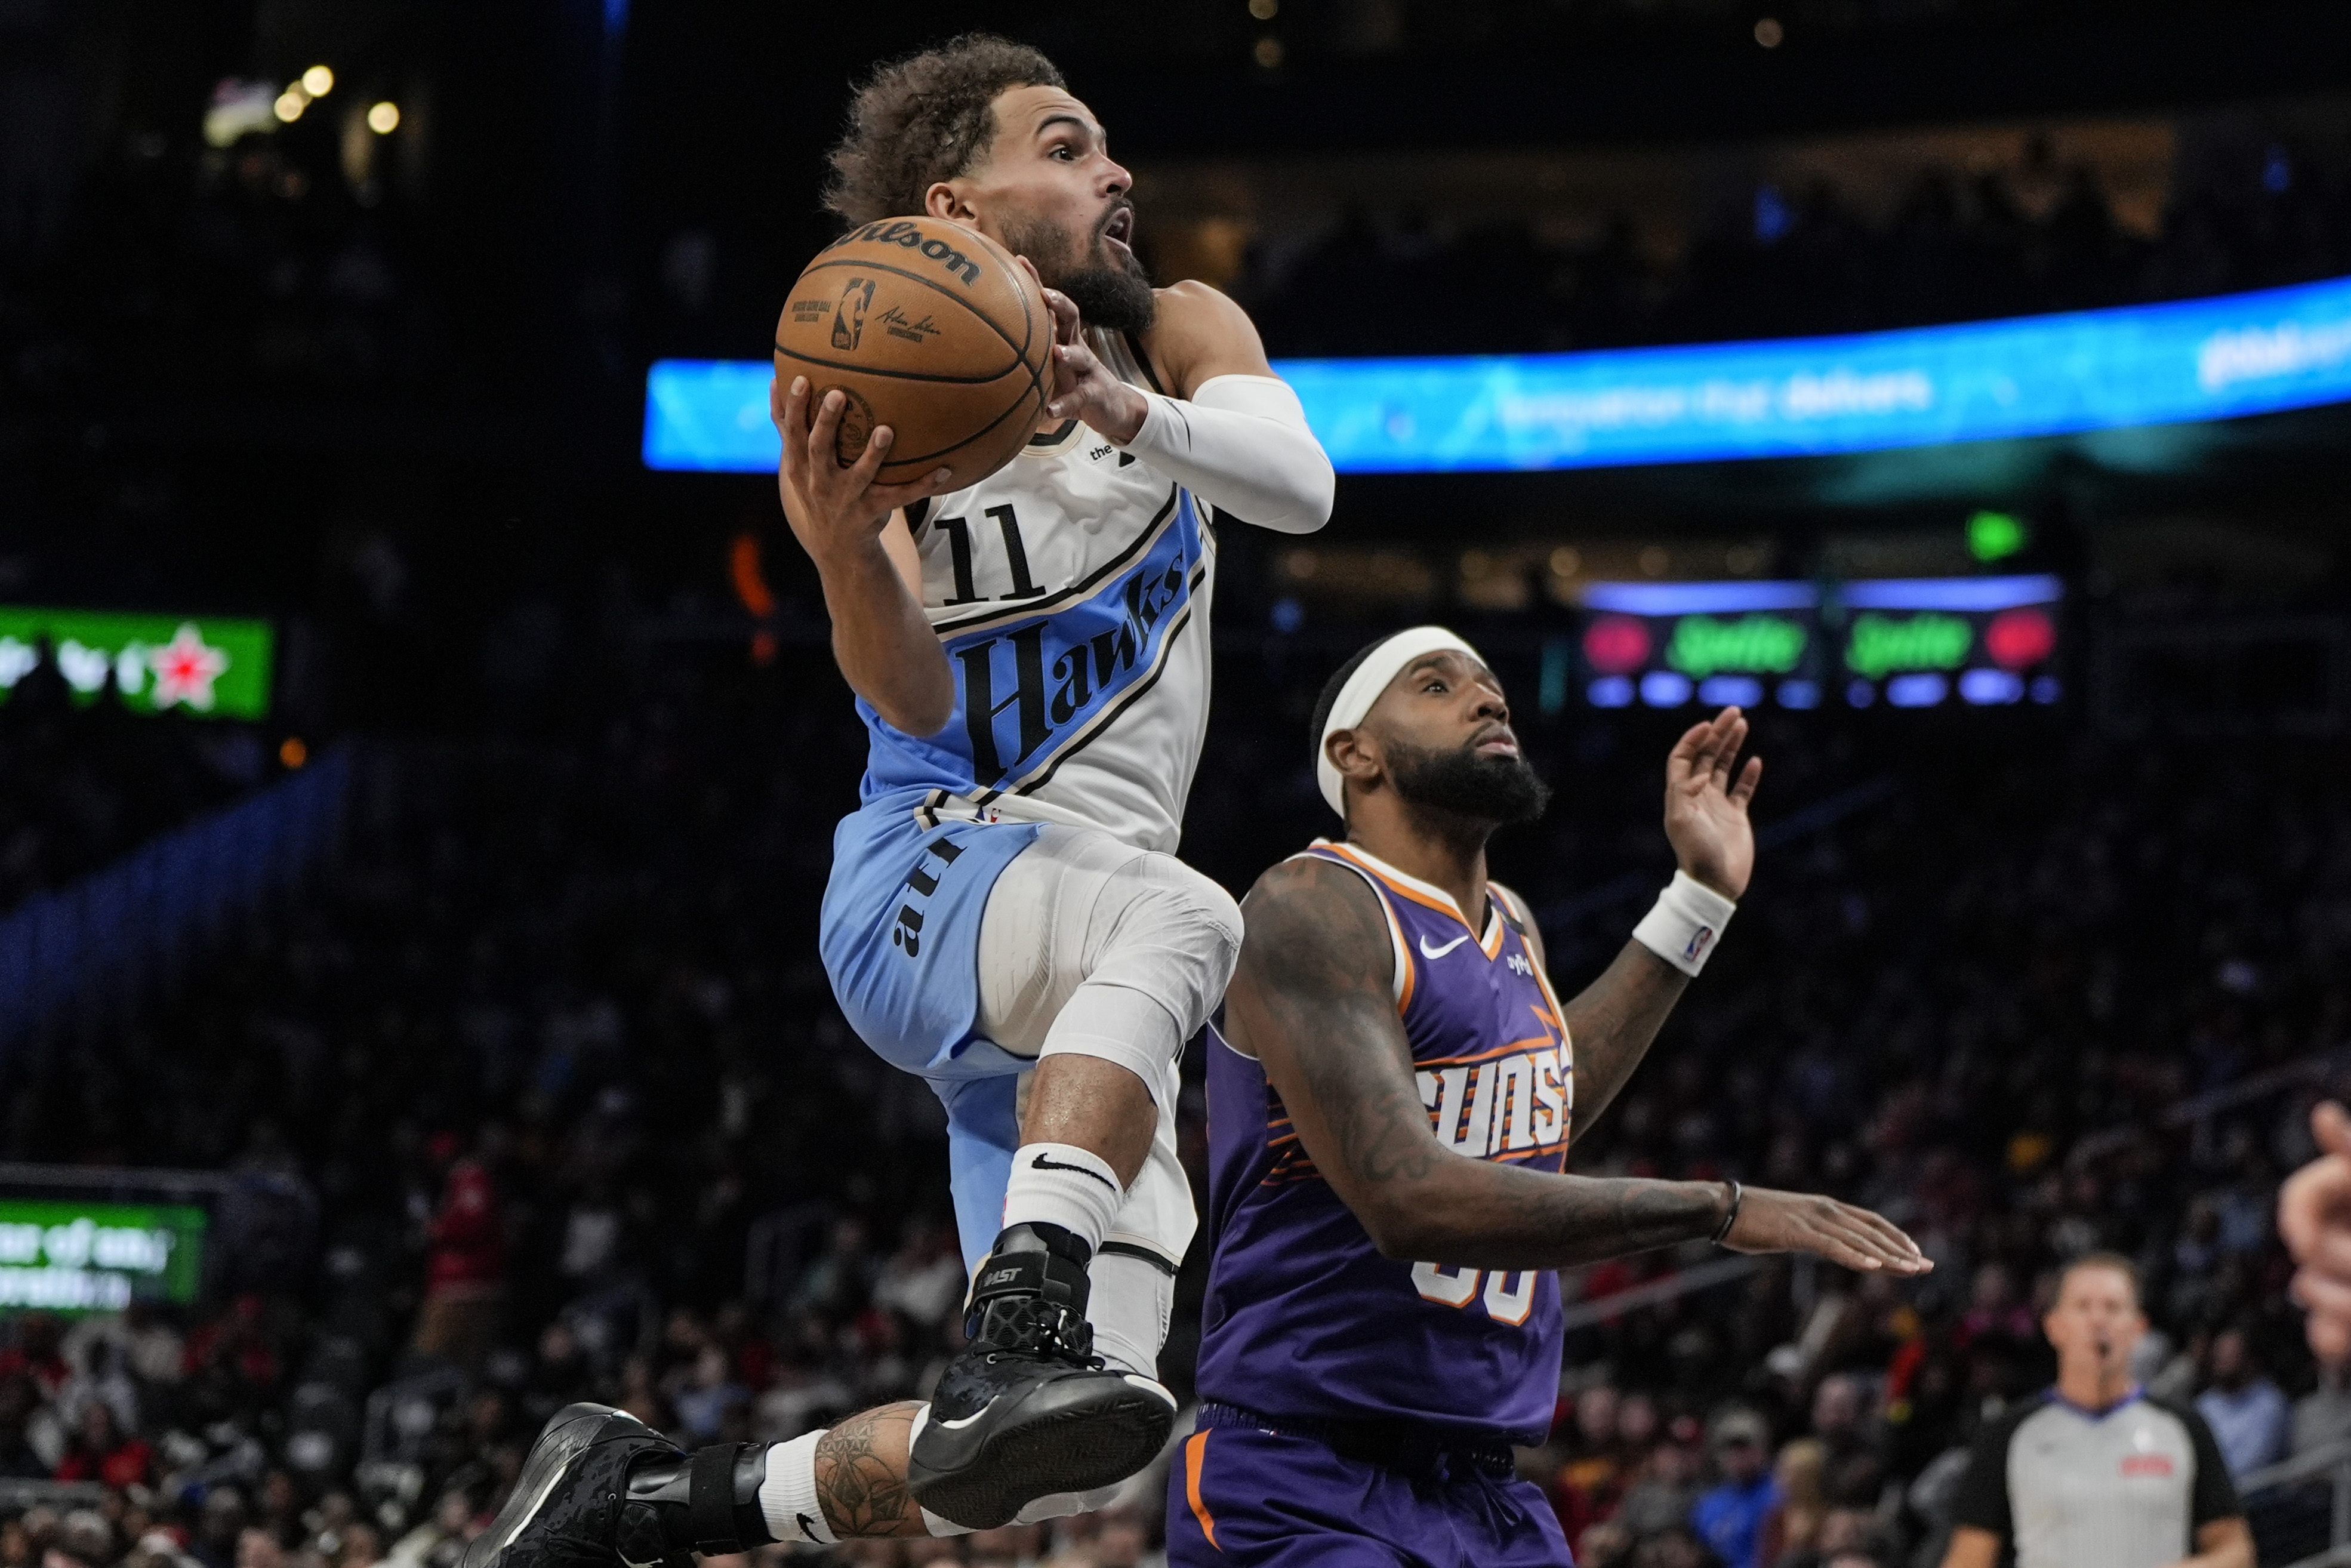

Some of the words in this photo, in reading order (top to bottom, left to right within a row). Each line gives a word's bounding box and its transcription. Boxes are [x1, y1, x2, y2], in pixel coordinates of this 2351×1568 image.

[1090, 445, 1113, 461] the
[934, 504, 1046, 607] 11
[955, 549, 1184, 790] Hawks
